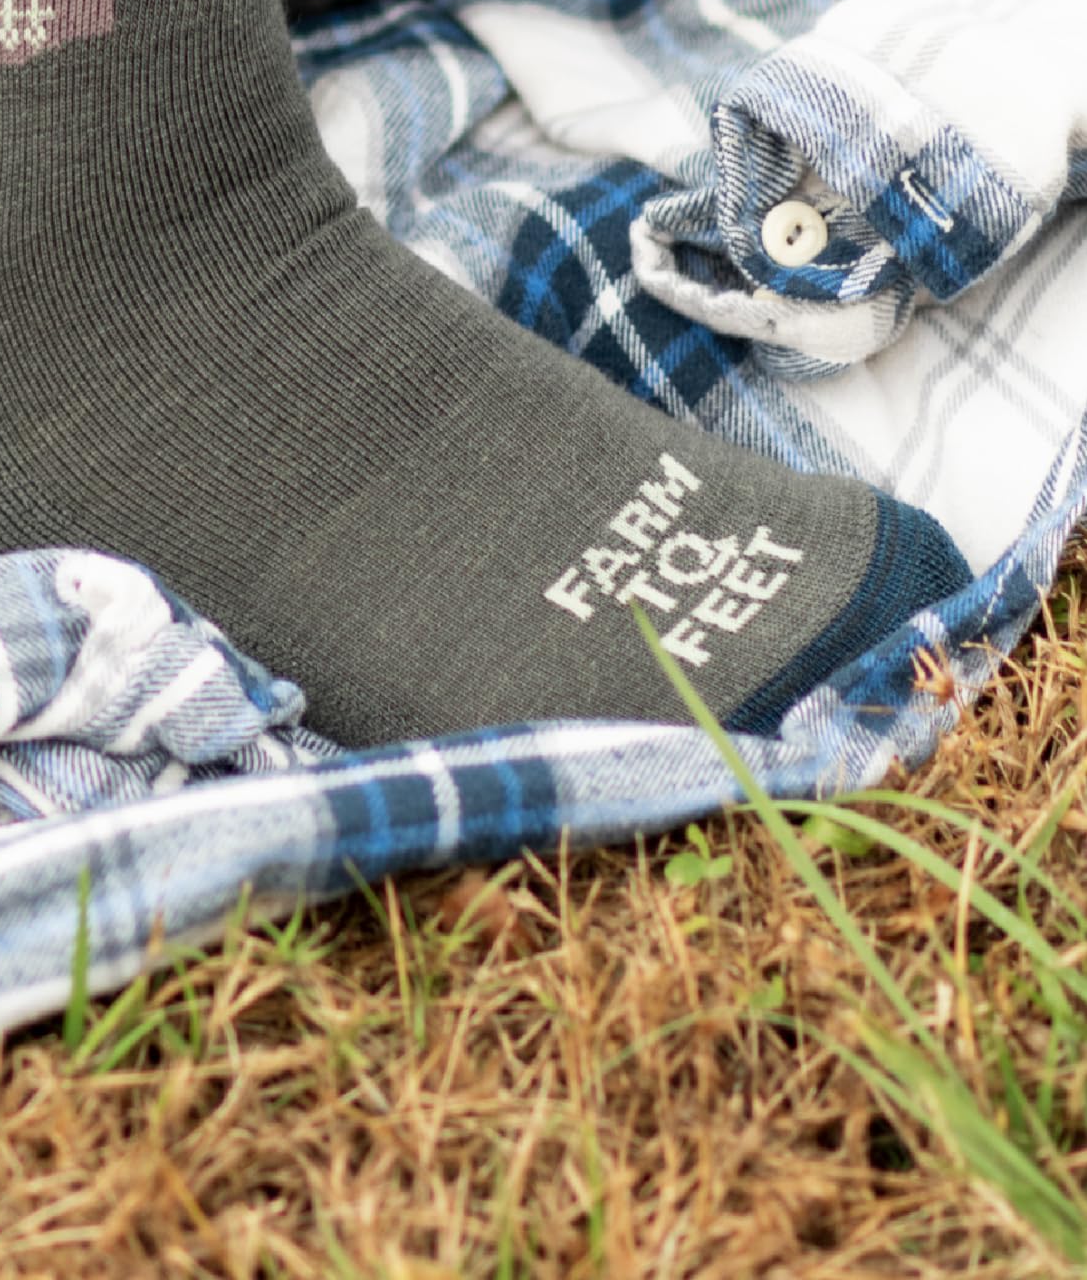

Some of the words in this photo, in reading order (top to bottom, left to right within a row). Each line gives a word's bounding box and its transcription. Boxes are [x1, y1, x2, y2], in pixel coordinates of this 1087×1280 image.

[543, 451, 703, 622] FARM
[616, 529, 740, 614] TO
[660, 524, 804, 668] FEET
